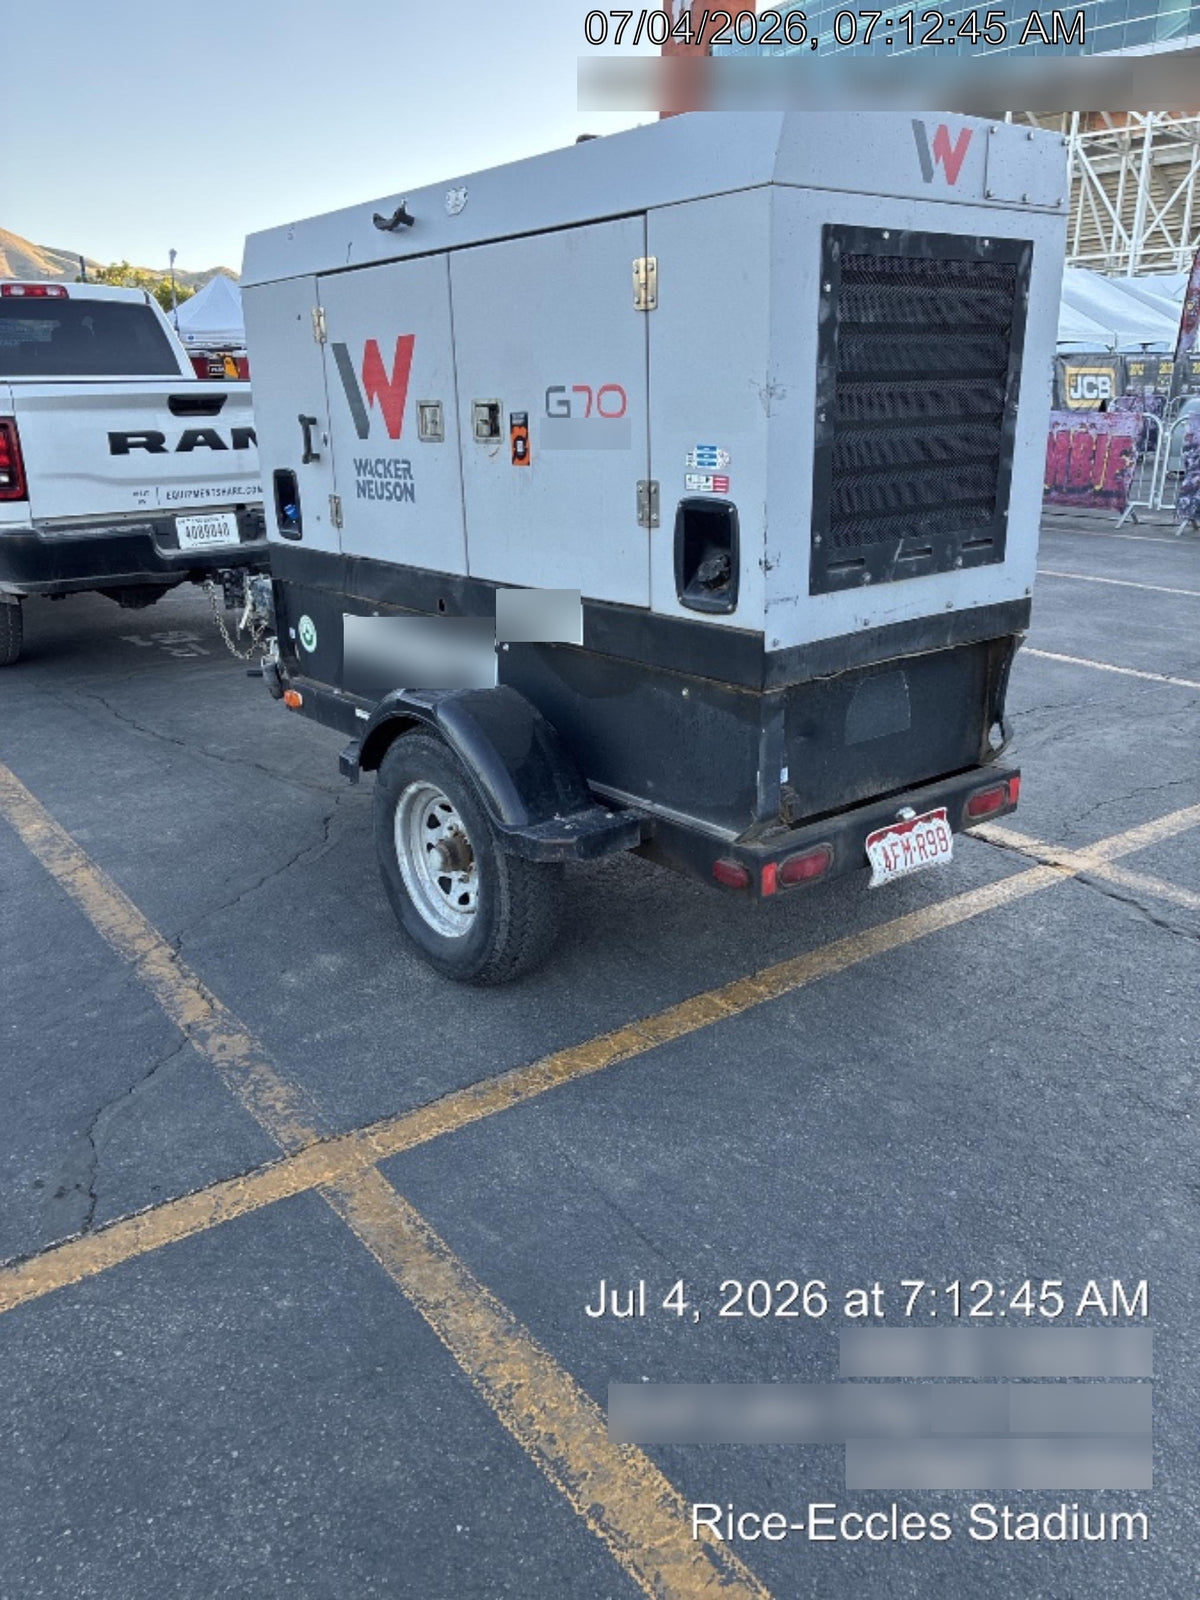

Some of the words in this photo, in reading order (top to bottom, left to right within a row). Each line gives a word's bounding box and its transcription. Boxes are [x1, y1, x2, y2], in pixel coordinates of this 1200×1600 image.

[1070, 374, 1111, 400] JCB
[545, 383, 627, 419] G70
[353, 458, 414, 480] WACKER
[356, 479, 415, 503] NEUSON
